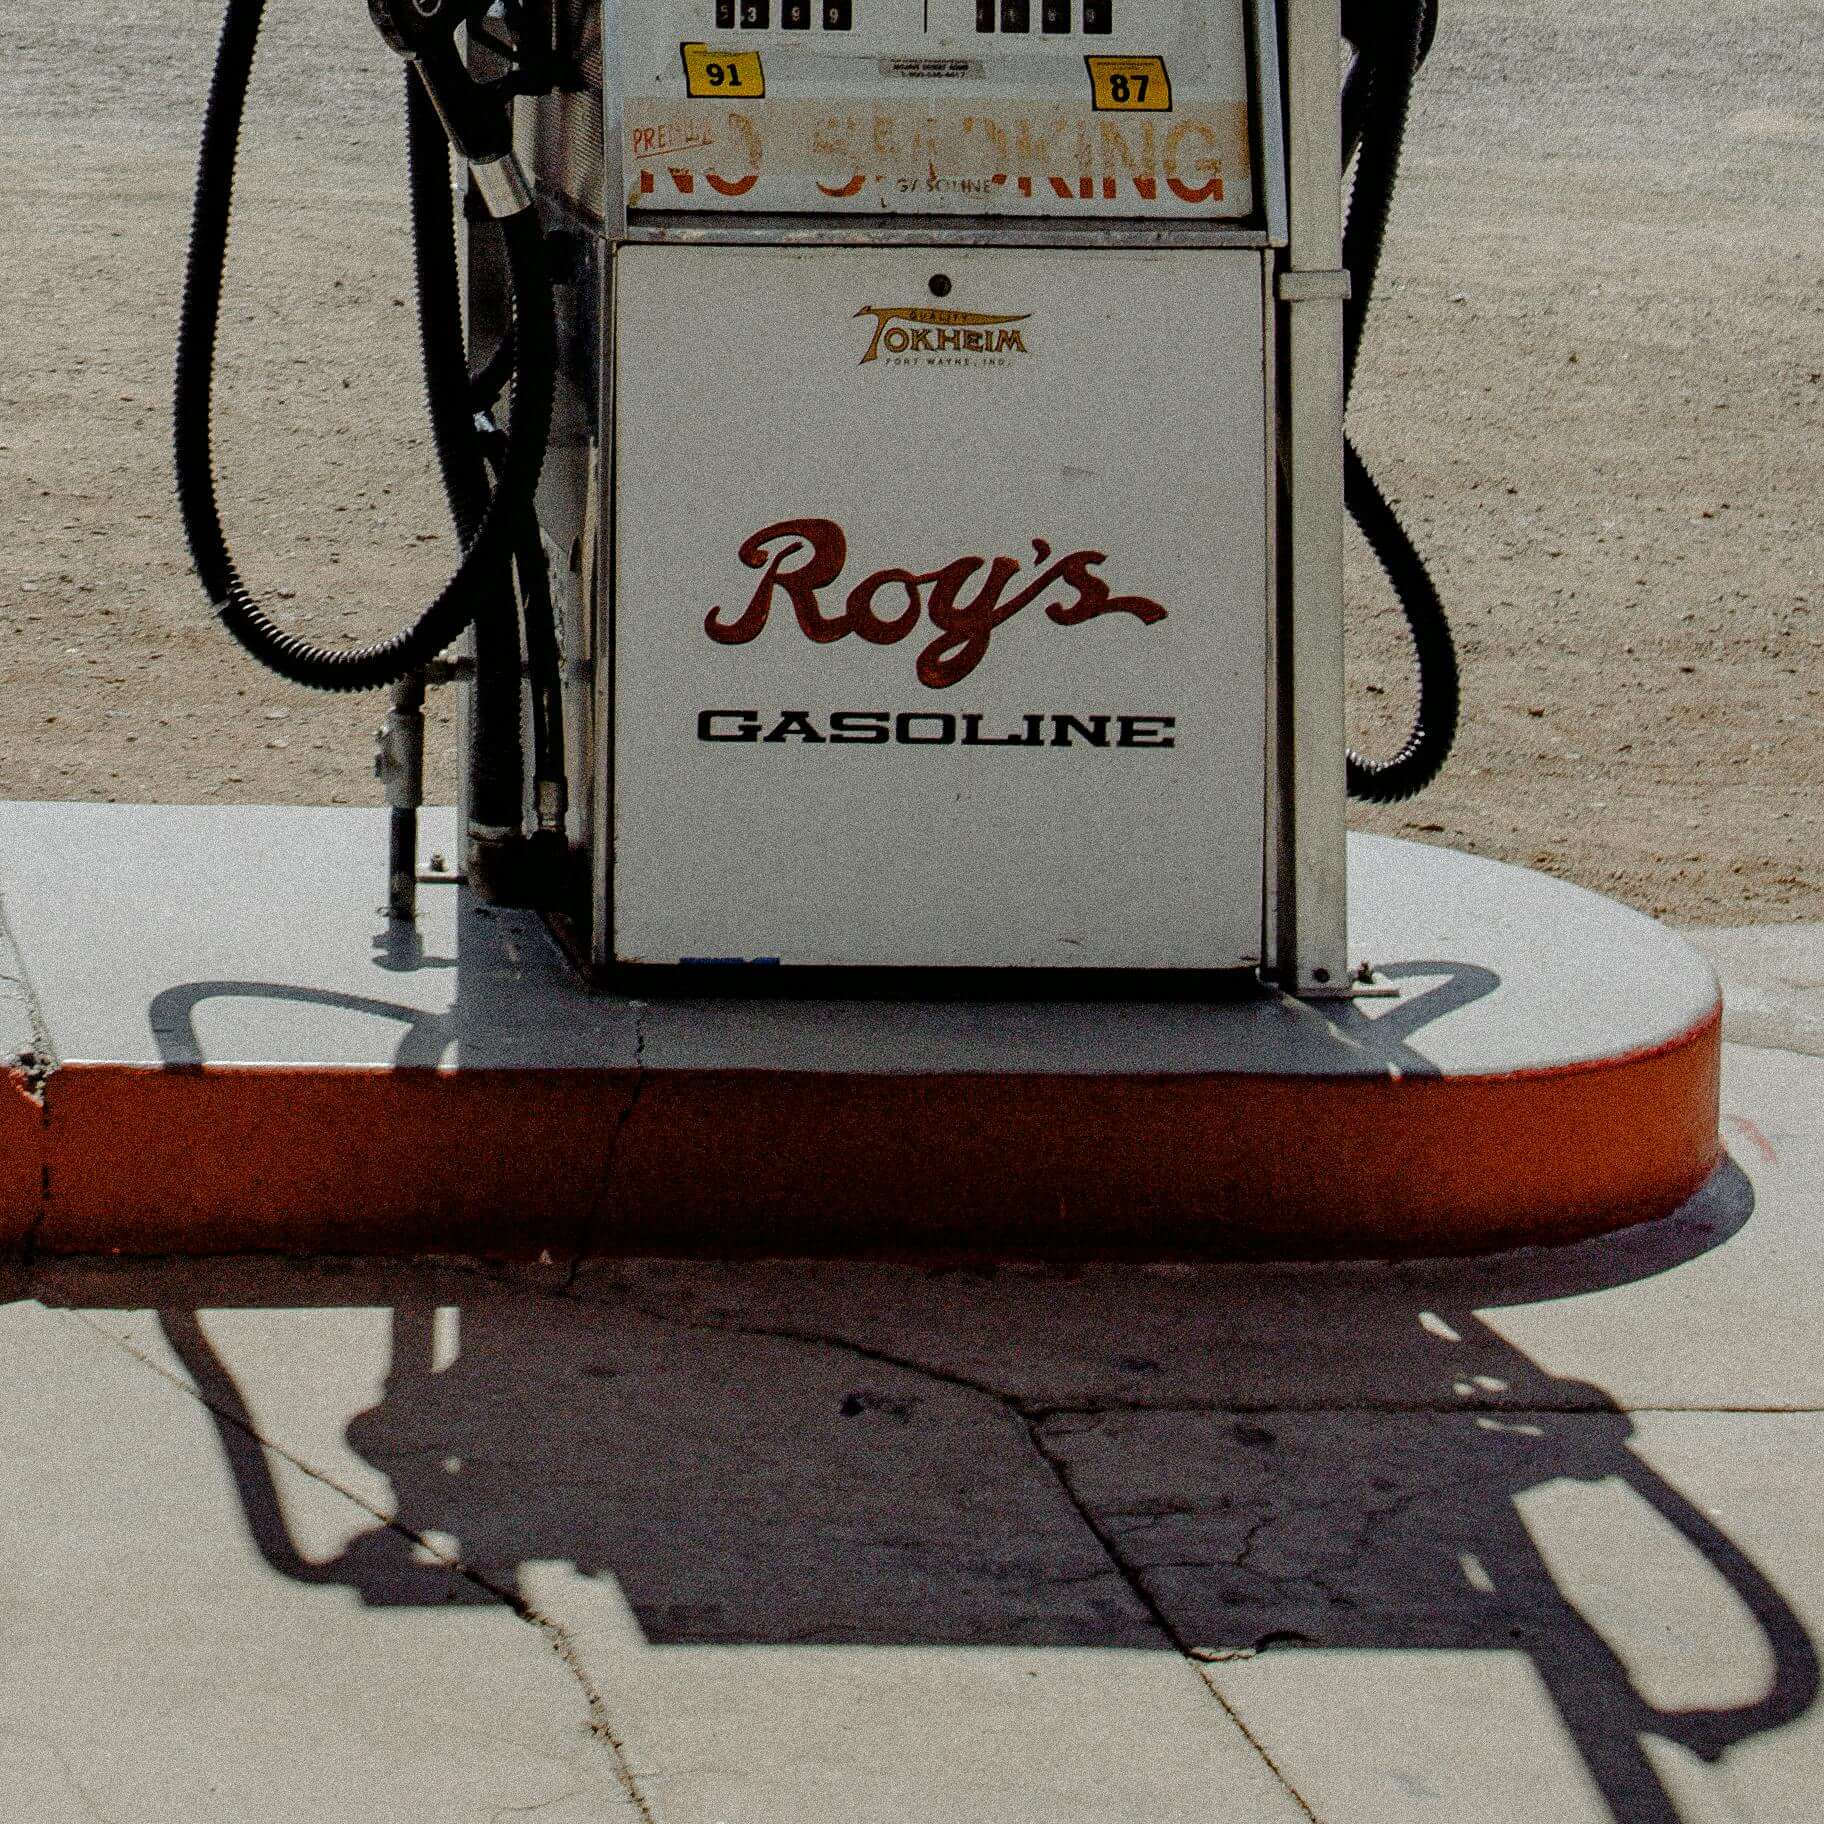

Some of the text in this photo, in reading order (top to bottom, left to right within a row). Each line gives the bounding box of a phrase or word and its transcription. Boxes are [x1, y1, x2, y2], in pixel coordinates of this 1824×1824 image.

[705, 63, 743, 87] 91
[1109, 74, 1150, 103] 87
[853, 305, 1033, 366] TOKHEIM
[885, 357, 919, 366] FORT
[703, 518, 1168, 689] Roy's
[697, 709, 1176, 749] GASOLINE
